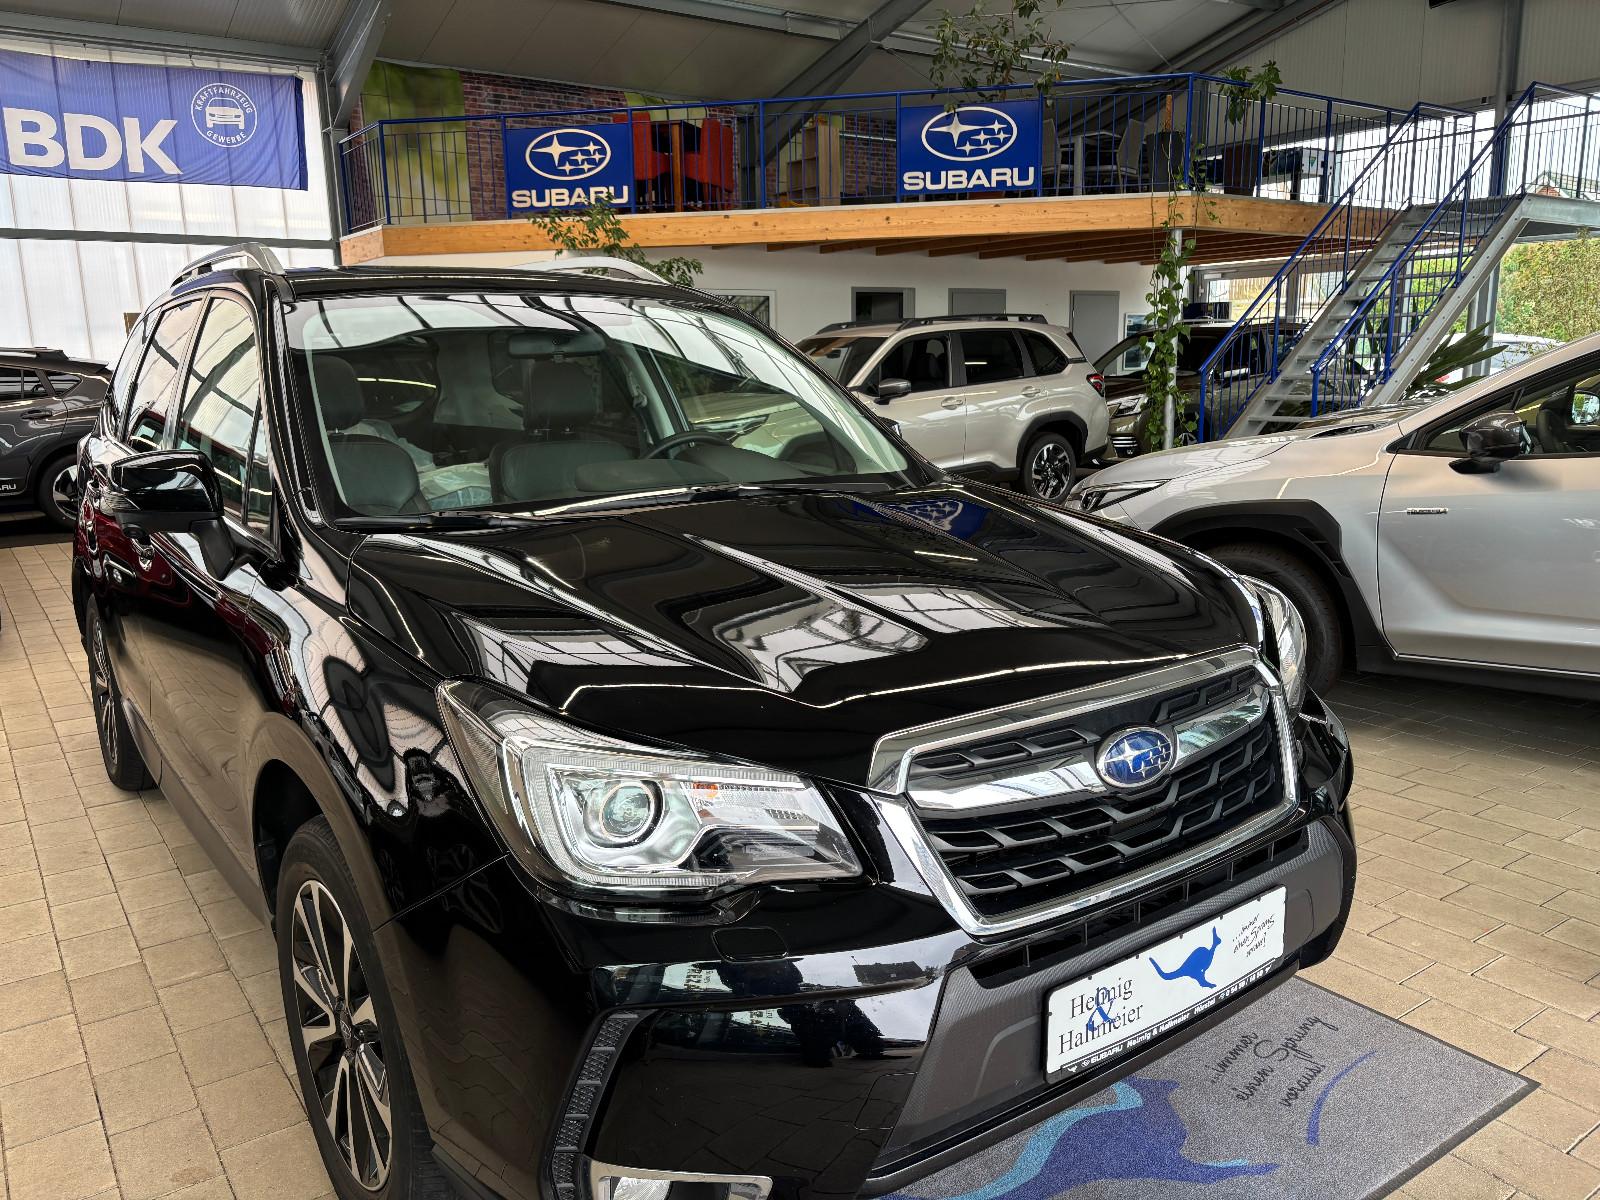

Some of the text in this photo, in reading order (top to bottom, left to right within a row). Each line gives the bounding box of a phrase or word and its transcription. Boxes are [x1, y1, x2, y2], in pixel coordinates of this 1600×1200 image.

[195, 87, 253, 114] KRAFTFAHRZEUG
[3, 107, 184, 175] BDK
[206, 130, 246, 143] GEWERBE
[903, 166, 1036, 191] SUBARU
[511, 185, 629, 208] SUBARU
[1071, 977, 1133, 1019] Helmig
[1058, 1004, 1143, 1056] Hallmeier
[1090, 1044, 1123, 1064] SUBARU
[1232, 1016, 1339, 1101] einen Sprung
